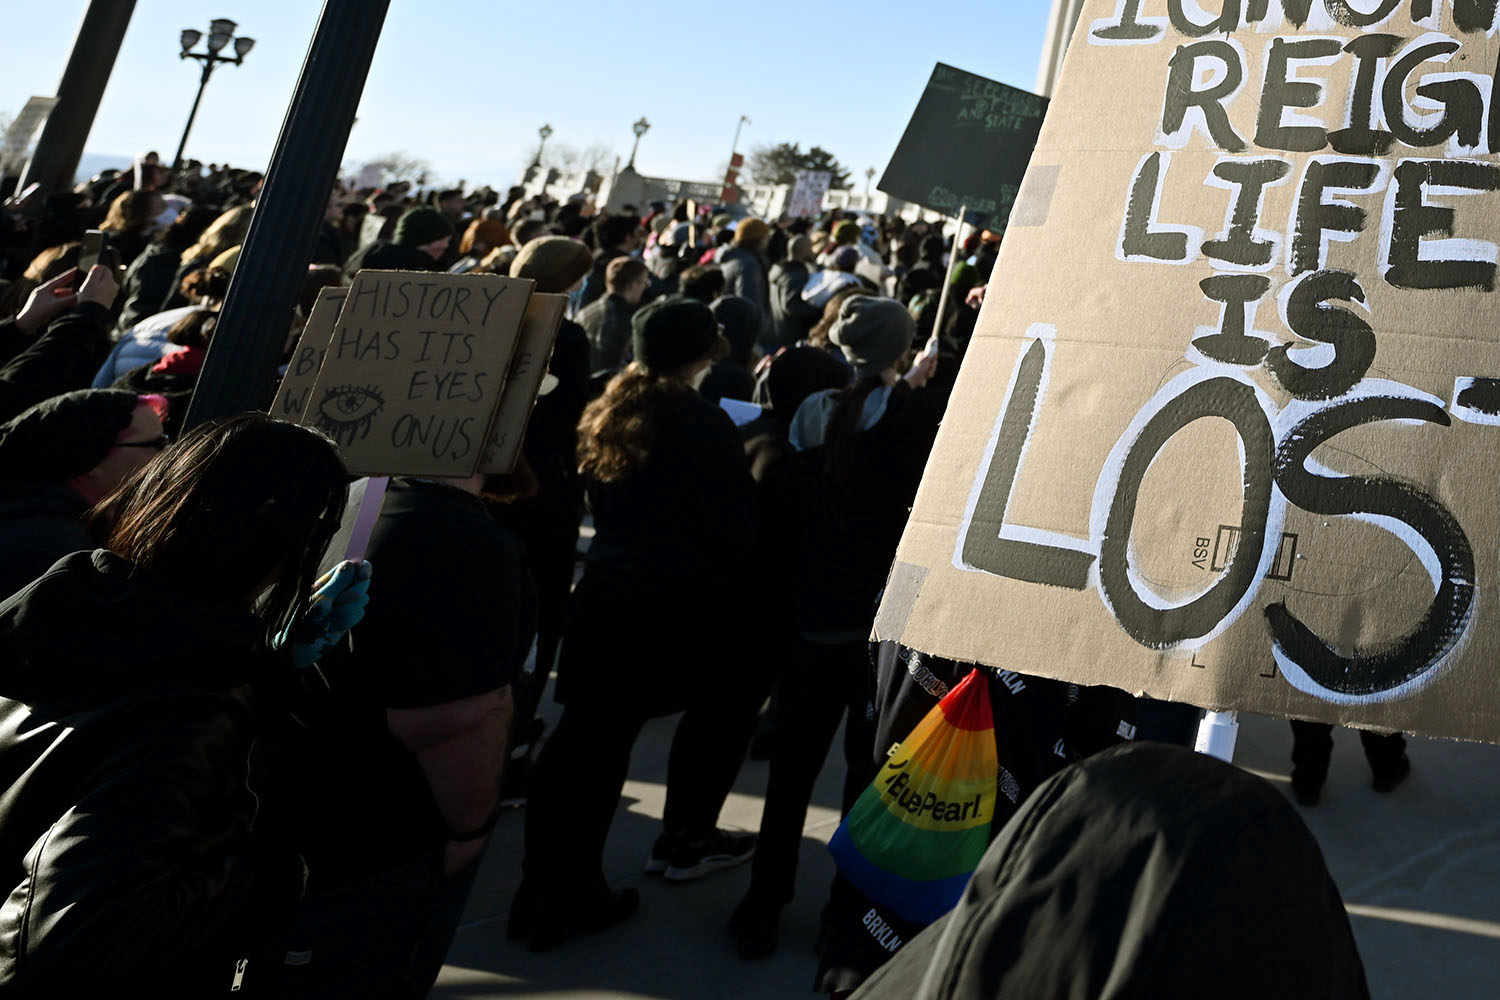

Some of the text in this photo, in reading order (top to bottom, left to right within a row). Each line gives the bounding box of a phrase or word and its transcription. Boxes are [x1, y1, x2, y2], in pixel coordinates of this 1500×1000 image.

[351, 279, 508, 326] HISTORY
[336, 327, 475, 364] HAS ITS
[1185, 269, 1376, 399] IS
[408, 371, 487, 401] EYES
[1191, 537, 1210, 570] BSV
[899, 648, 949, 700] BROOKLY
[862, 907, 902, 952] BRKLN
